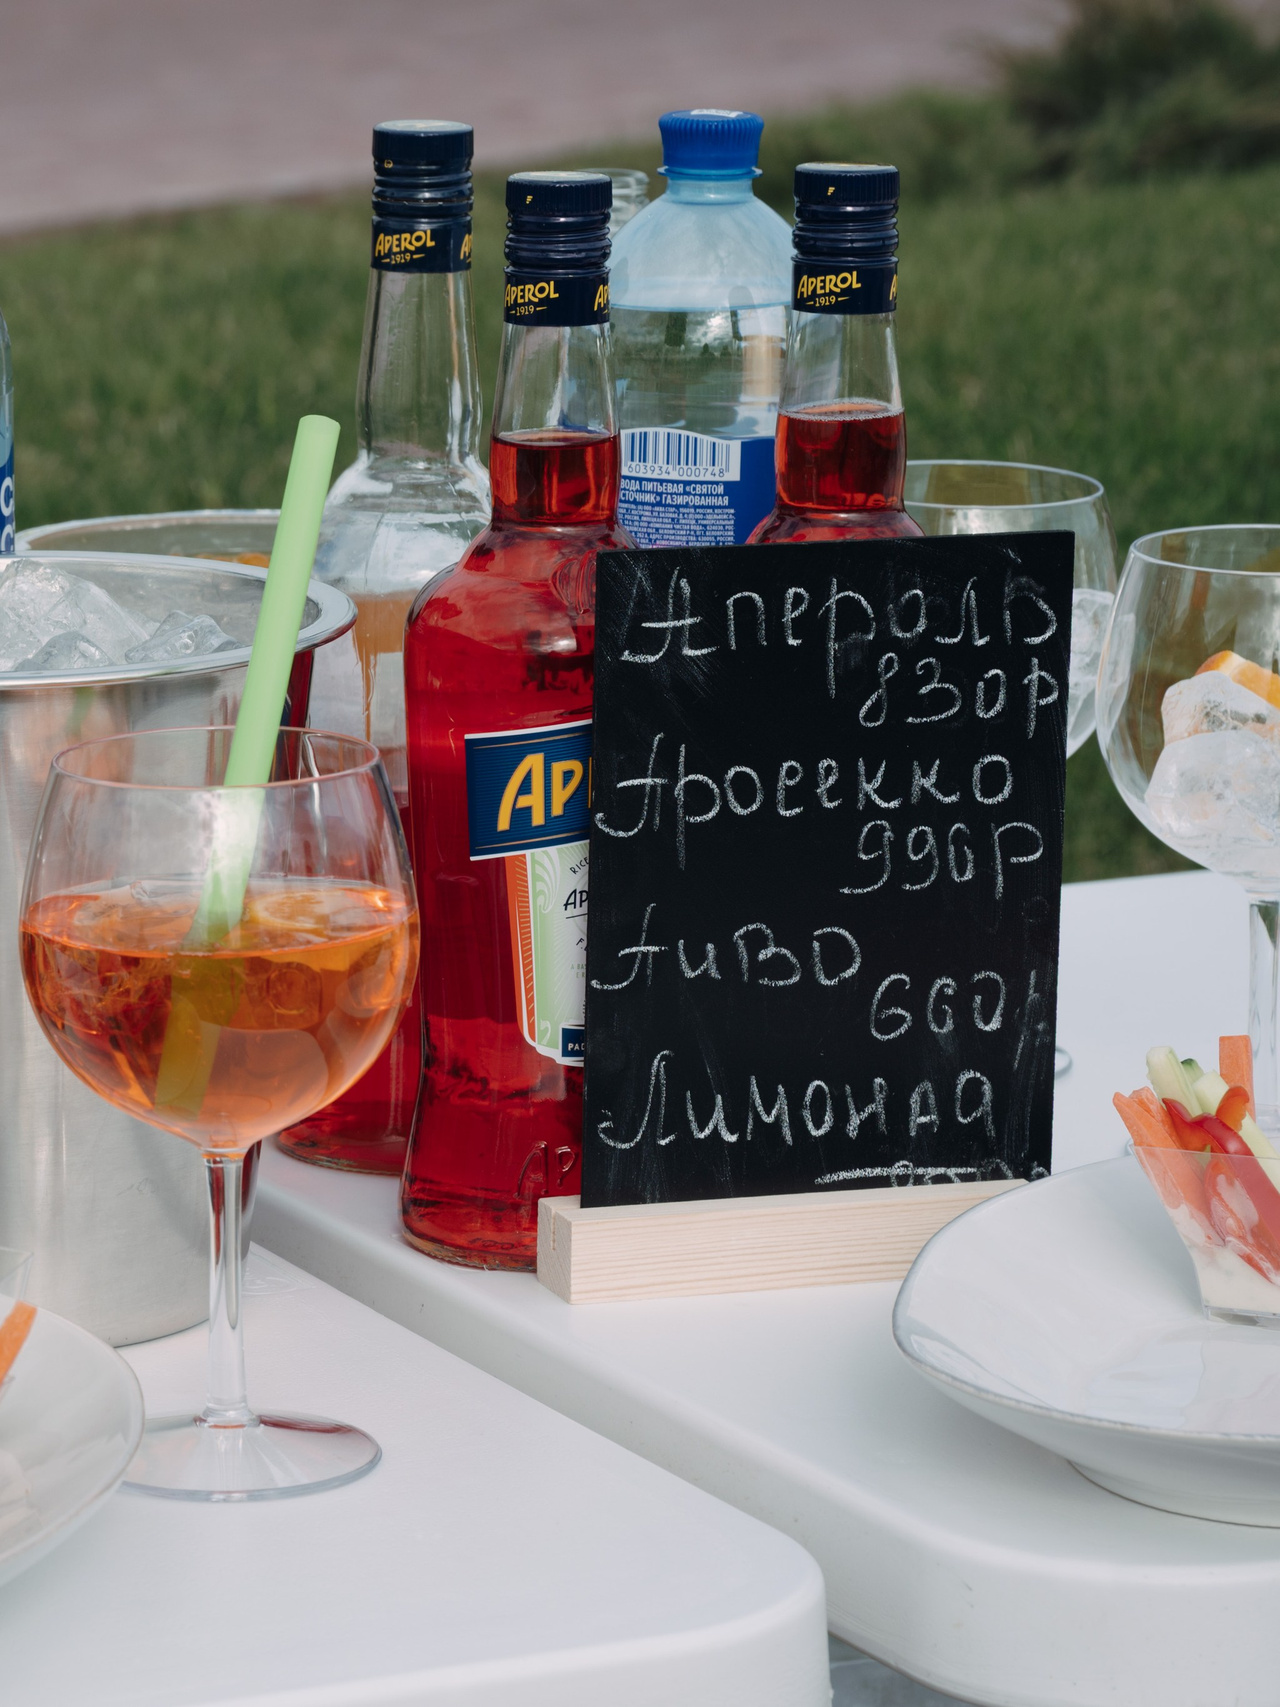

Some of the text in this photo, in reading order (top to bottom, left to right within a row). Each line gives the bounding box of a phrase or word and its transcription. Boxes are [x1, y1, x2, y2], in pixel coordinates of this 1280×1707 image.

[375, 230, 435, 257] APEROL
[391, 253, 411, 264] 1919
[797, 271, 861, 299] APEROL
[504, 281, 559, 307] APEROL
[815, 295, 836, 307] 1919
[516, 305, 535, 316] 1919
[627, 463, 725, 478] 603934 000748
[621, 479, 640, 490] ВОДА
[642, 481, 683, 493] ПИТЬЕВАЯ
[620, 490, 729, 506] СТОЧНИК» ГАЗИРОВАННАЯ
[497, 752, 592, 832] AP
[597, 1050, 997, 1149] Лимонад
